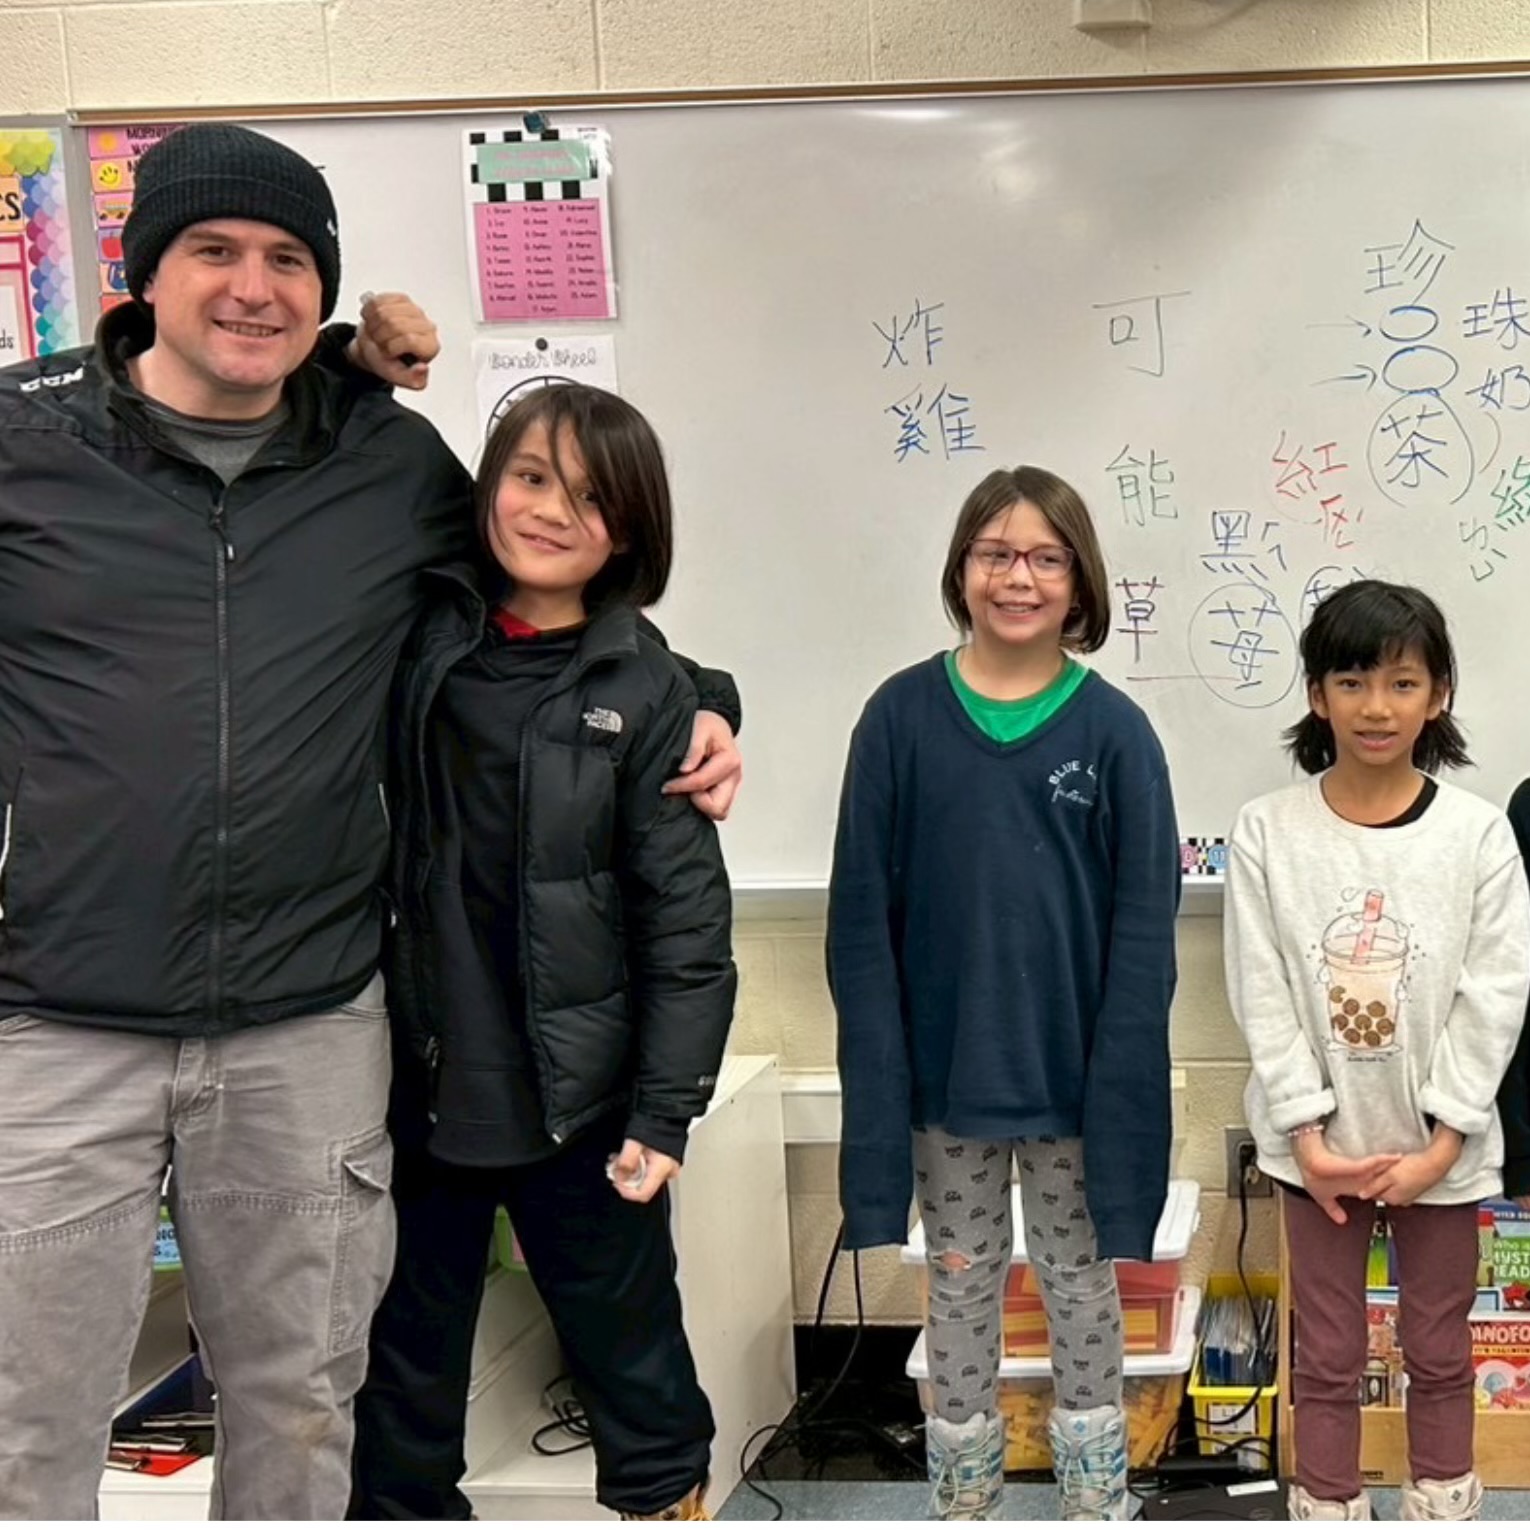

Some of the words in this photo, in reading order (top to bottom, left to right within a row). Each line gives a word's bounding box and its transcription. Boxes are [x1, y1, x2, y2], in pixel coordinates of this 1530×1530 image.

[1364, 219, 1454, 306] 珍
[1274, 431, 1346, 497] 紅
[1385, 406, 1446, 487] 茶
[1049, 760, 1081, 785] BLUE
